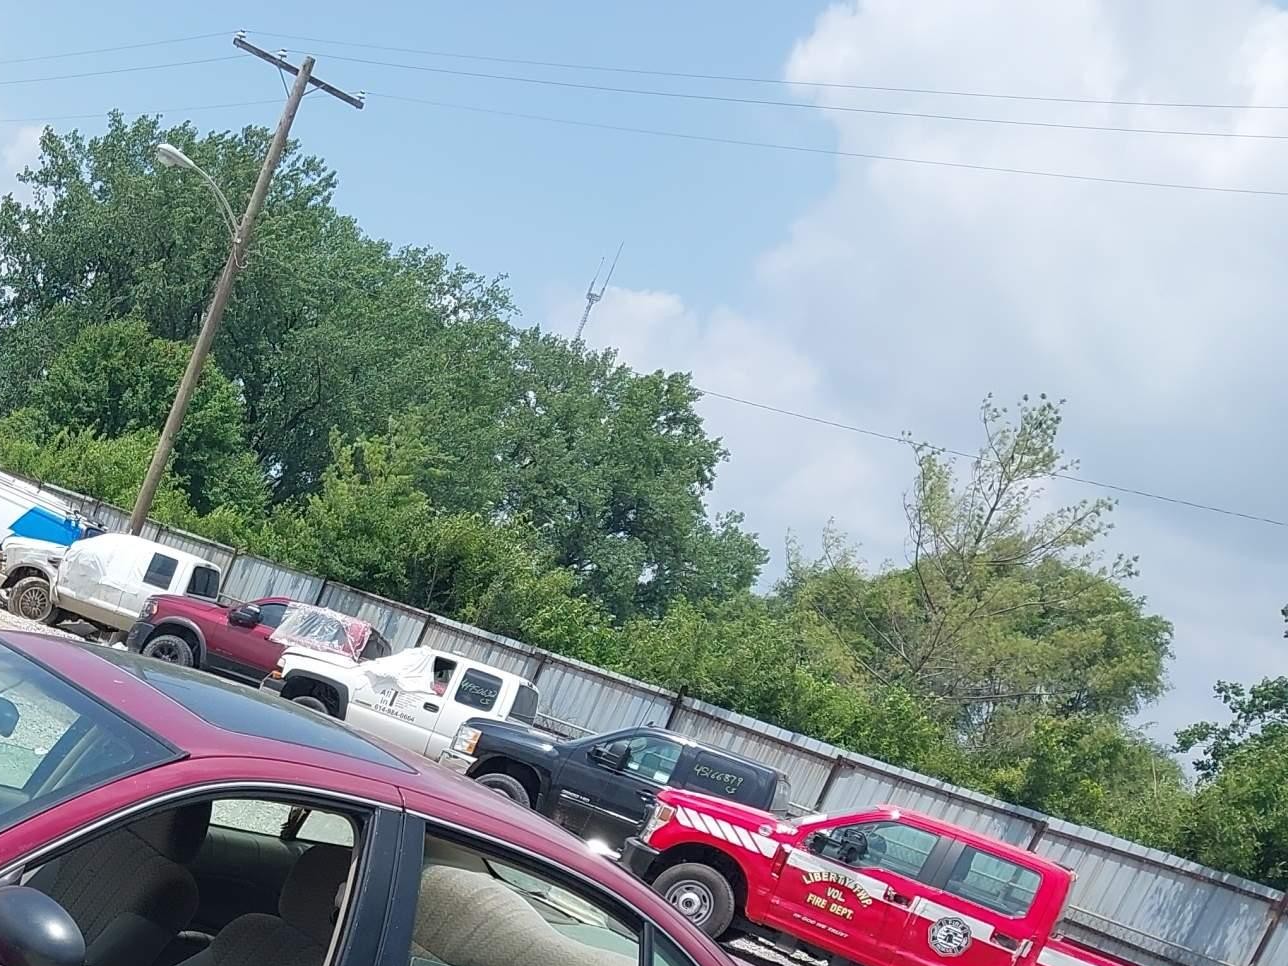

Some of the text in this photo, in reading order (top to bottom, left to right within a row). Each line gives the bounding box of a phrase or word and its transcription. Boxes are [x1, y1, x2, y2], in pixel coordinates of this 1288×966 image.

[802, 871, 854, 889] LIBERTY
[806, 893, 854, 920] FIRE DEPT.
